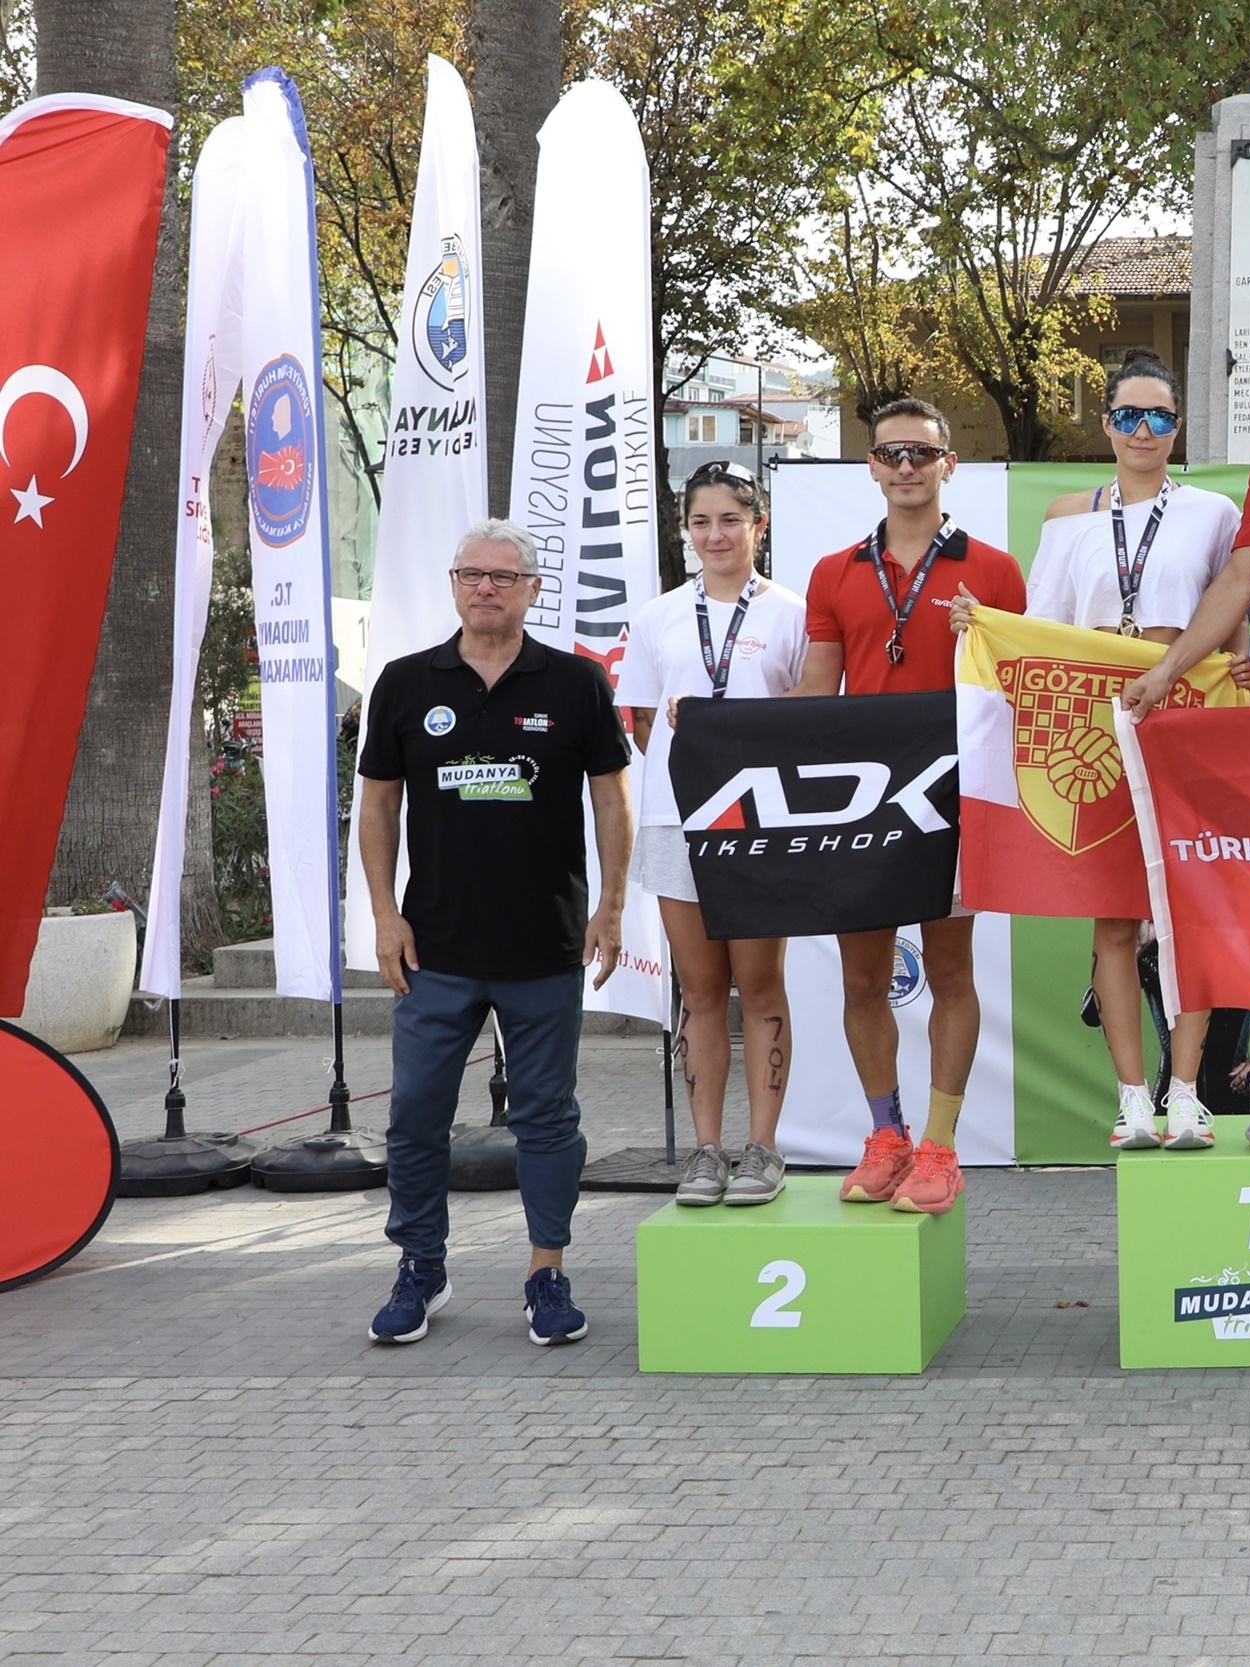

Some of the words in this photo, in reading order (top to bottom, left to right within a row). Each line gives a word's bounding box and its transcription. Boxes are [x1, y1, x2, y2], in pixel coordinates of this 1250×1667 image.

[441, 767, 518, 783] MUDANYA
[464, 778, 526, 795] triatlonu
[682, 754, 959, 834] ADK
[686, 838, 769, 857] IKE
[787, 830, 903, 854] SHOP
[749, 1258, 808, 1328] 2
